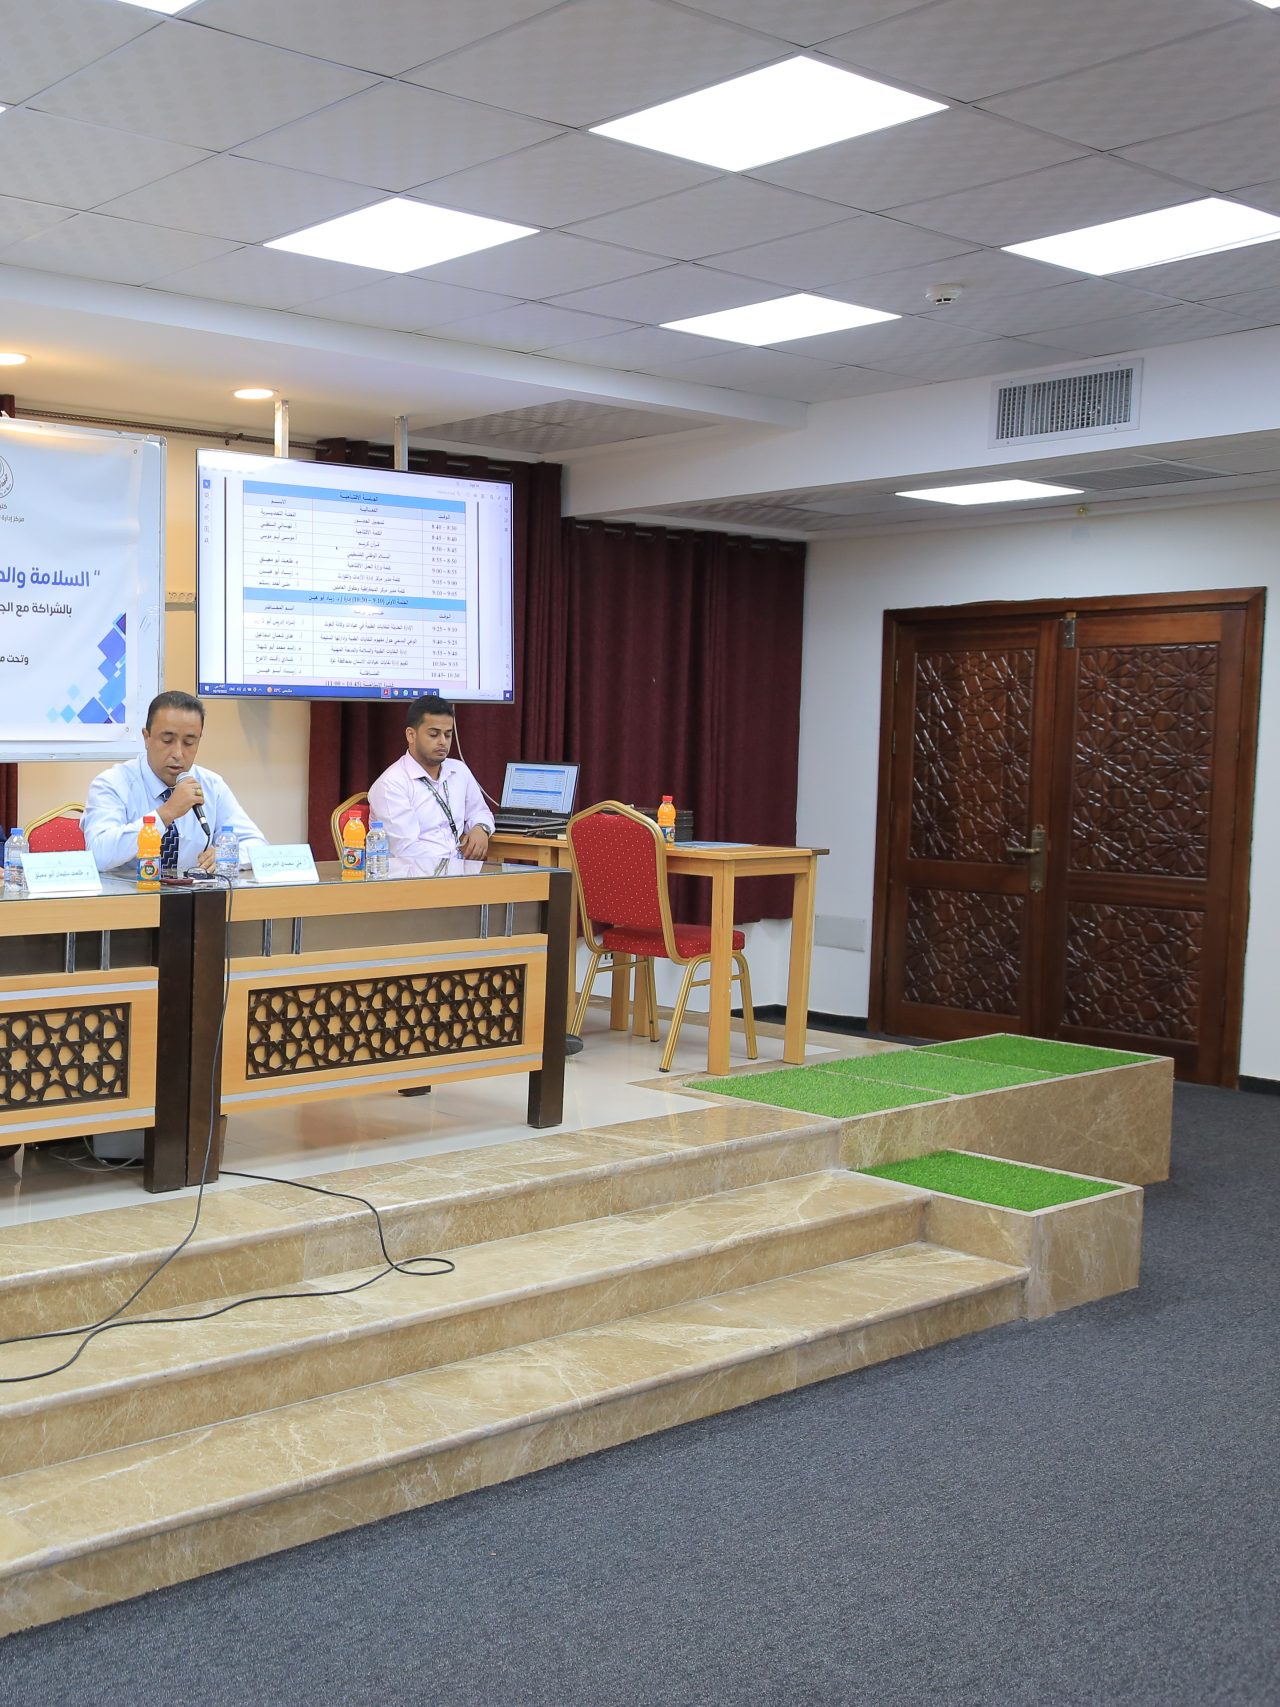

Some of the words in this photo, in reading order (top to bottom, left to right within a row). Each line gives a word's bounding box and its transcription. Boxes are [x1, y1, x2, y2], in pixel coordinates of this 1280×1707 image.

[29, 566, 89, 587] السلامة
[15, 604, 29, 617] مع
[31, 602, 72, 618] بالشراكة
[6, 654, 28, 665] وتحت
